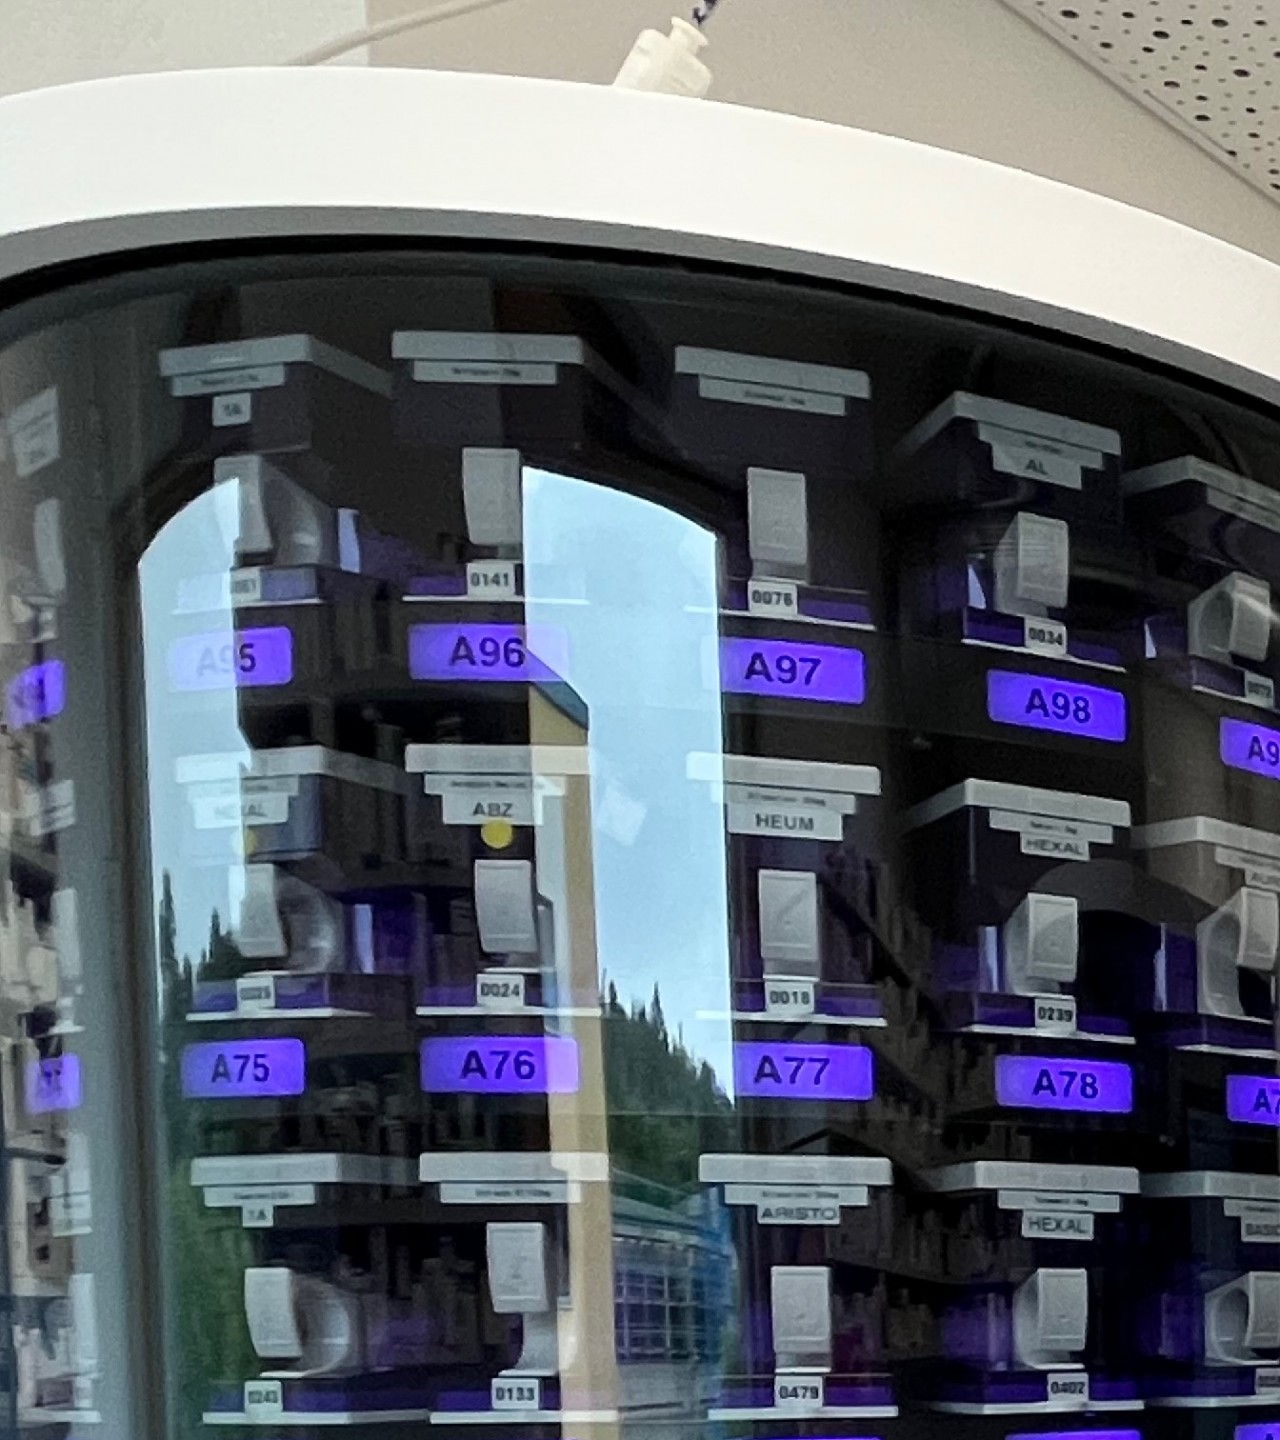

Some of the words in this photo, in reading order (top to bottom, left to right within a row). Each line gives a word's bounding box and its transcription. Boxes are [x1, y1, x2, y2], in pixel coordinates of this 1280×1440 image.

[1025, 459, 1046, 475] AL
[471, 572, 508, 586] 0141
[1028, 627, 1063, 647] 0034
[196, 643, 257, 678] A95
[448, 637, 526, 668] A96
[744, 652, 821, 685] A97
[1026, 688, 1090, 723] A98
[472, 802, 513, 817] ABZ
[756, 813, 814, 831] HEUM
[1026, 840, 1082, 855] HEXAL
[481, 982, 520, 997] 0024
[770, 991, 810, 1004] 0018
[1038, 1007, 1073, 1022] 0239
[211, 1054, 269, 1083] A75
[460, 1050, 534, 1079] A76
[754, 1055, 830, 1085] A77
[1032, 1069, 1098, 1098] A78
[761, 1207, 838, 1220] ARISTO
[1028, 1216, 1087, 1234] HEXAL
[496, 1387, 534, 1401] 0133
